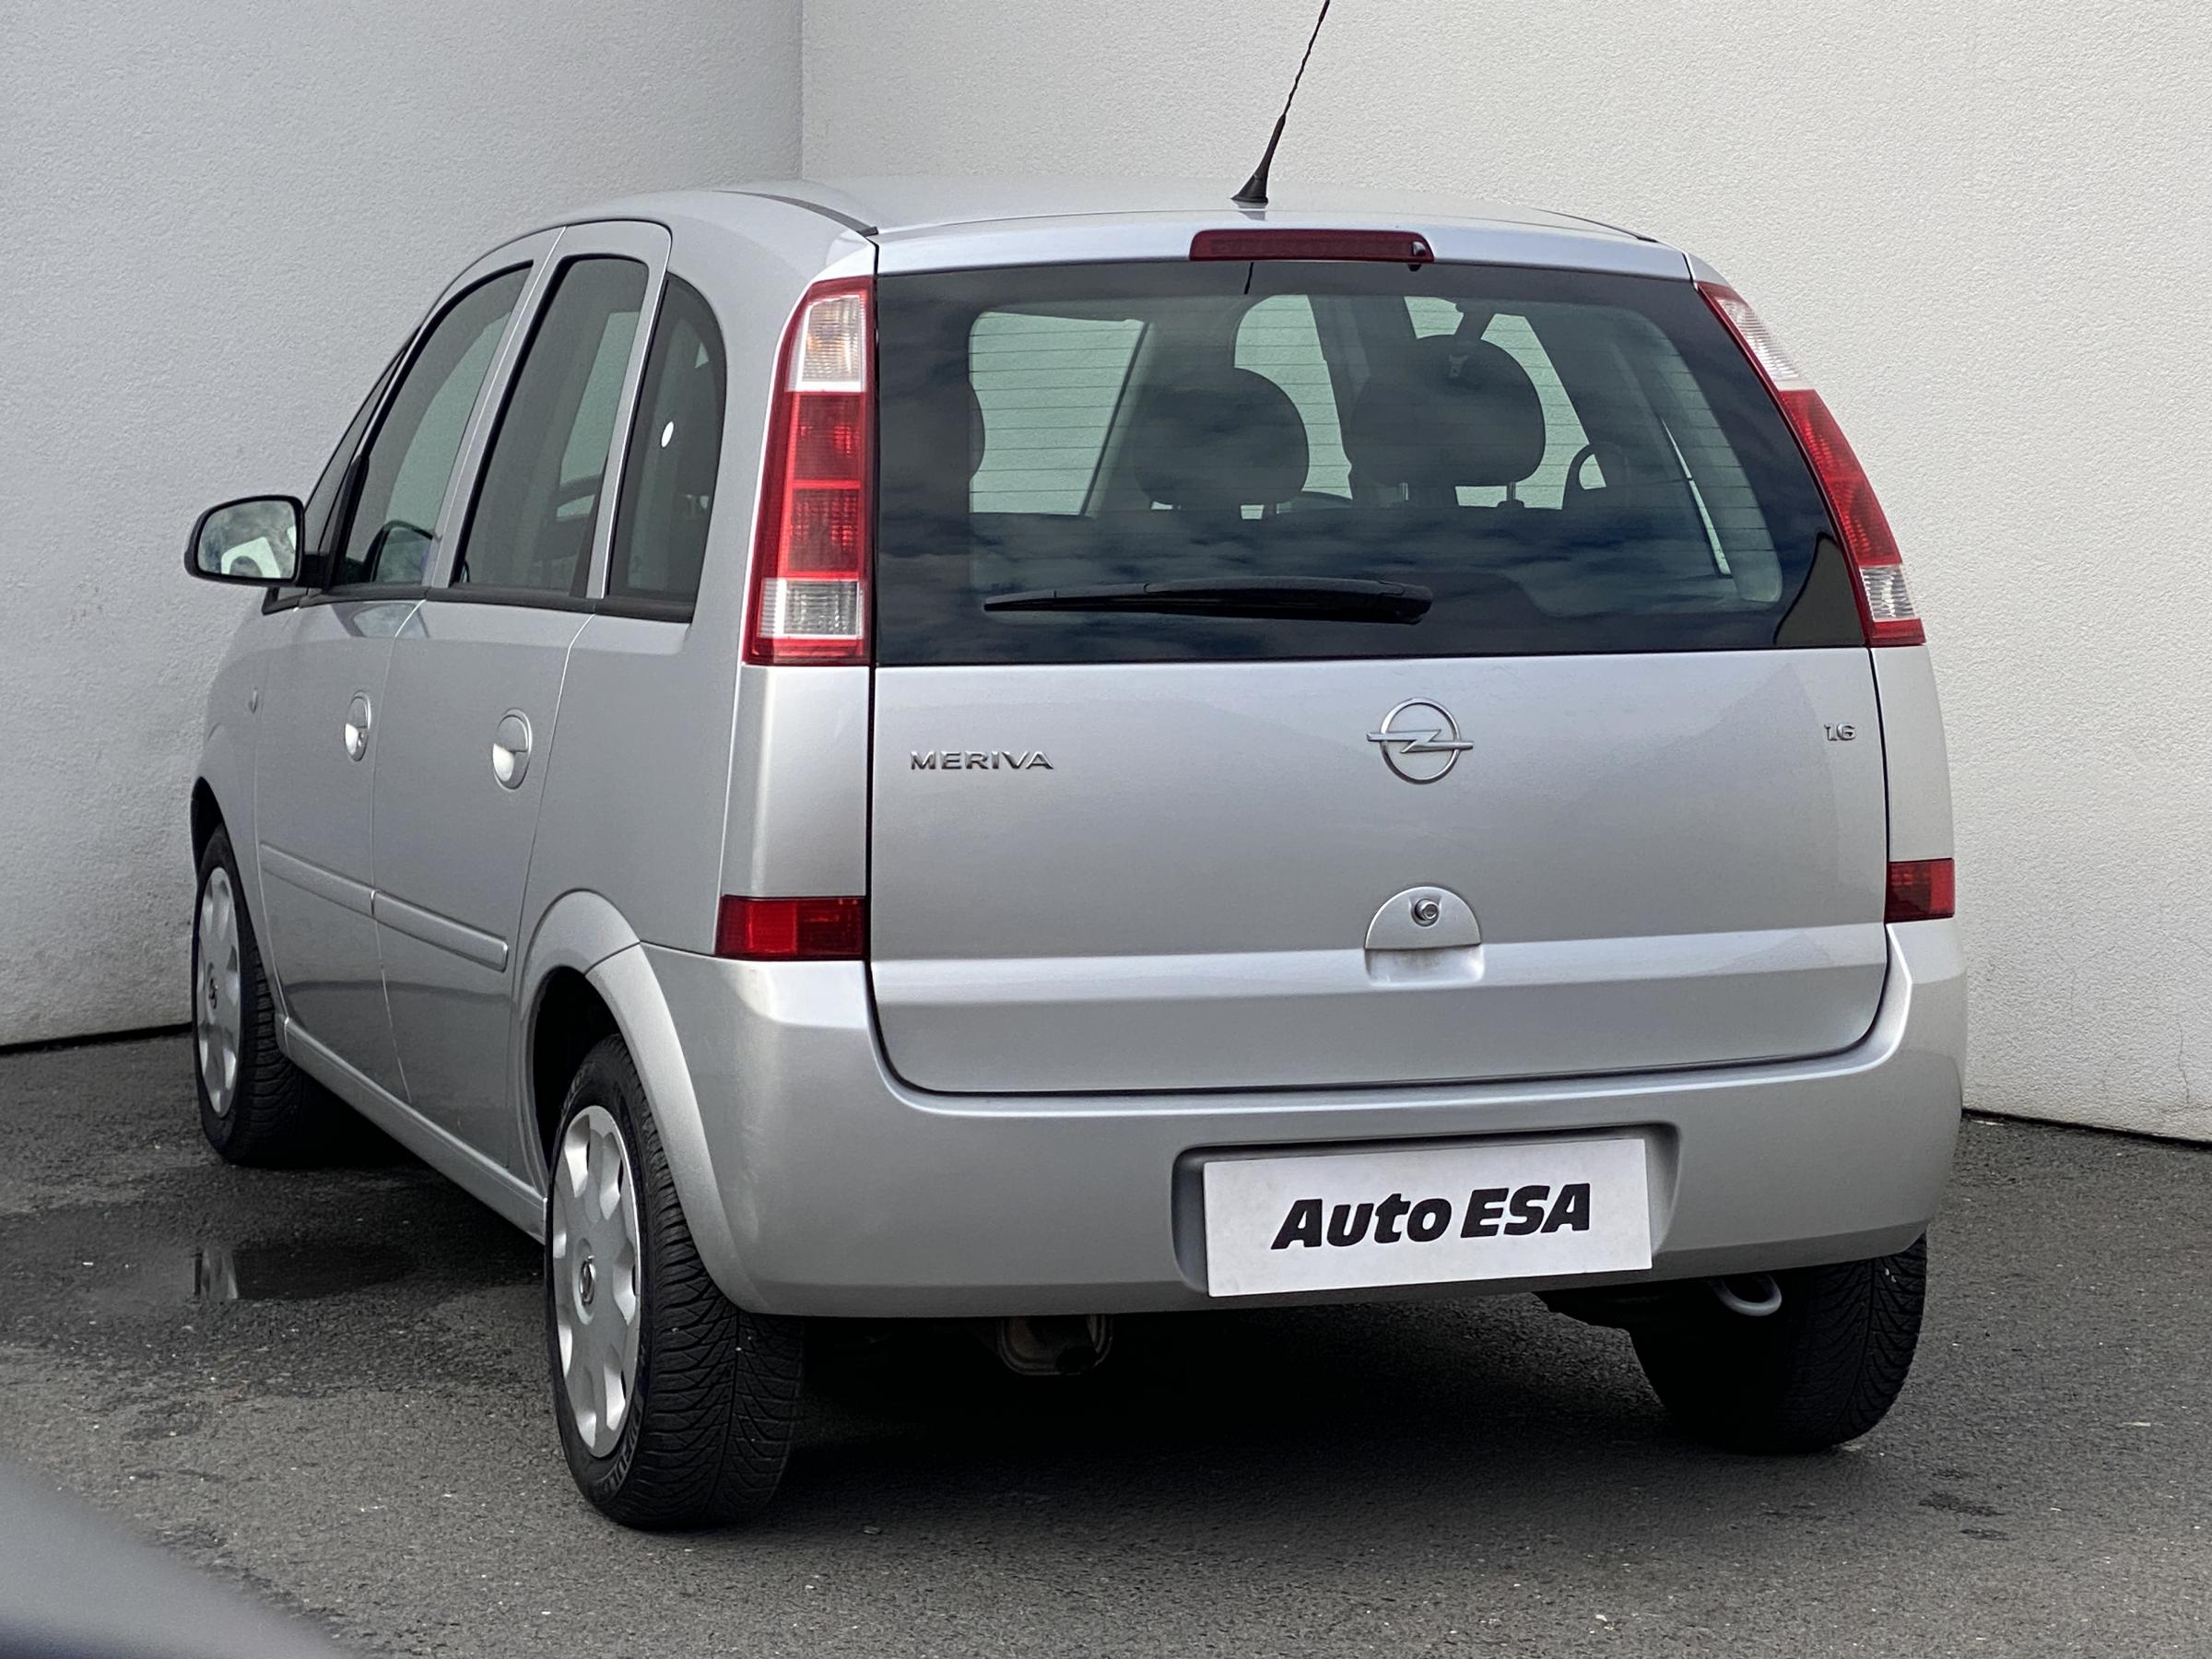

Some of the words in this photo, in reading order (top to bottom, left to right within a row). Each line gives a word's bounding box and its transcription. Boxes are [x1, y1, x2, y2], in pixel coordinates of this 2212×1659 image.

[911, 750, 1054, 771] MERIVA
[1270, 1193, 1452, 1250] Auto
[1460, 1182, 1591, 1239] ESA
